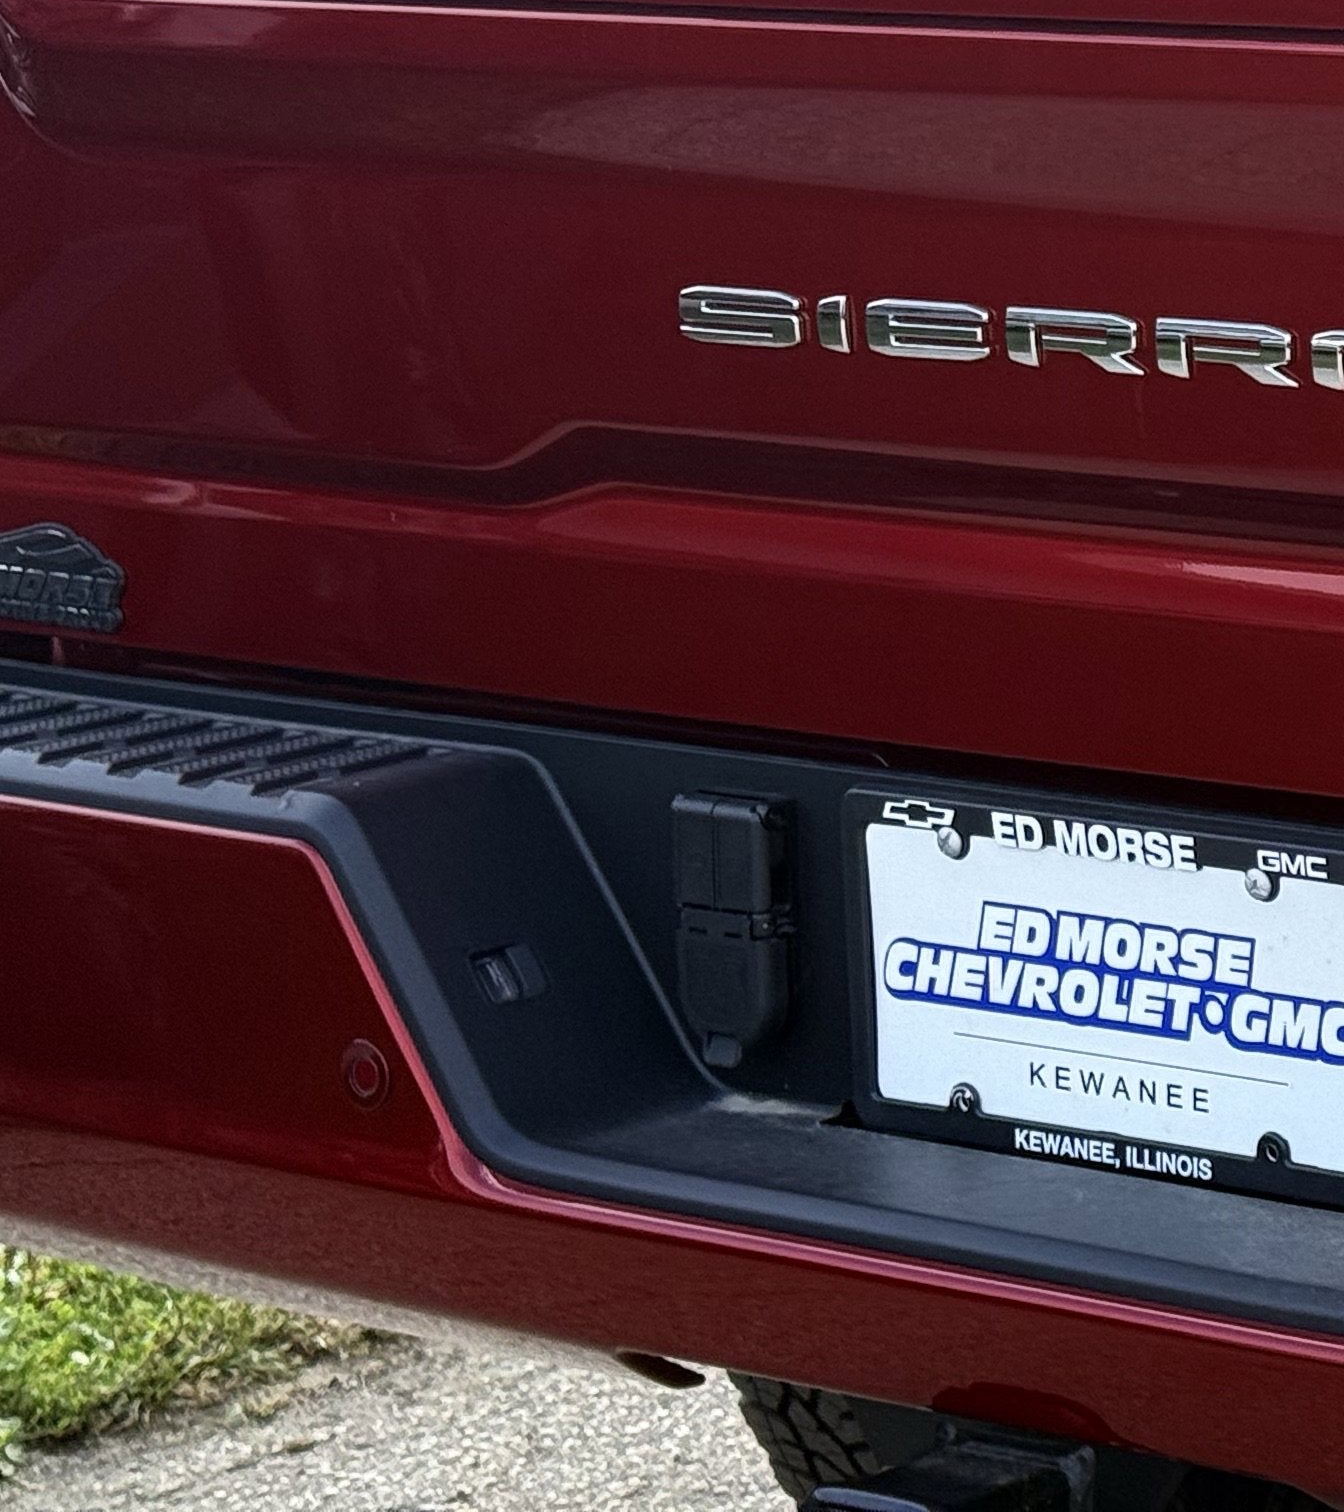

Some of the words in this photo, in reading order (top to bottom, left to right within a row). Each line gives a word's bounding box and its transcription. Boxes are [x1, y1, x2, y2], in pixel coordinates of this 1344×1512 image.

[991, 811, 1044, 851] ED
[1053, 818, 1200, 872] MORSE
[1256, 849, 1329, 879] GMC
[978, 901, 1052, 954] ED
[1056, 910, 1256, 986] MORSE
[1028, 1061, 1211, 1114] KEWANEE
[1013, 1127, 1121, 1169] KEWANEE,
[1125, 1144, 1213, 1181] ILLINOIS
